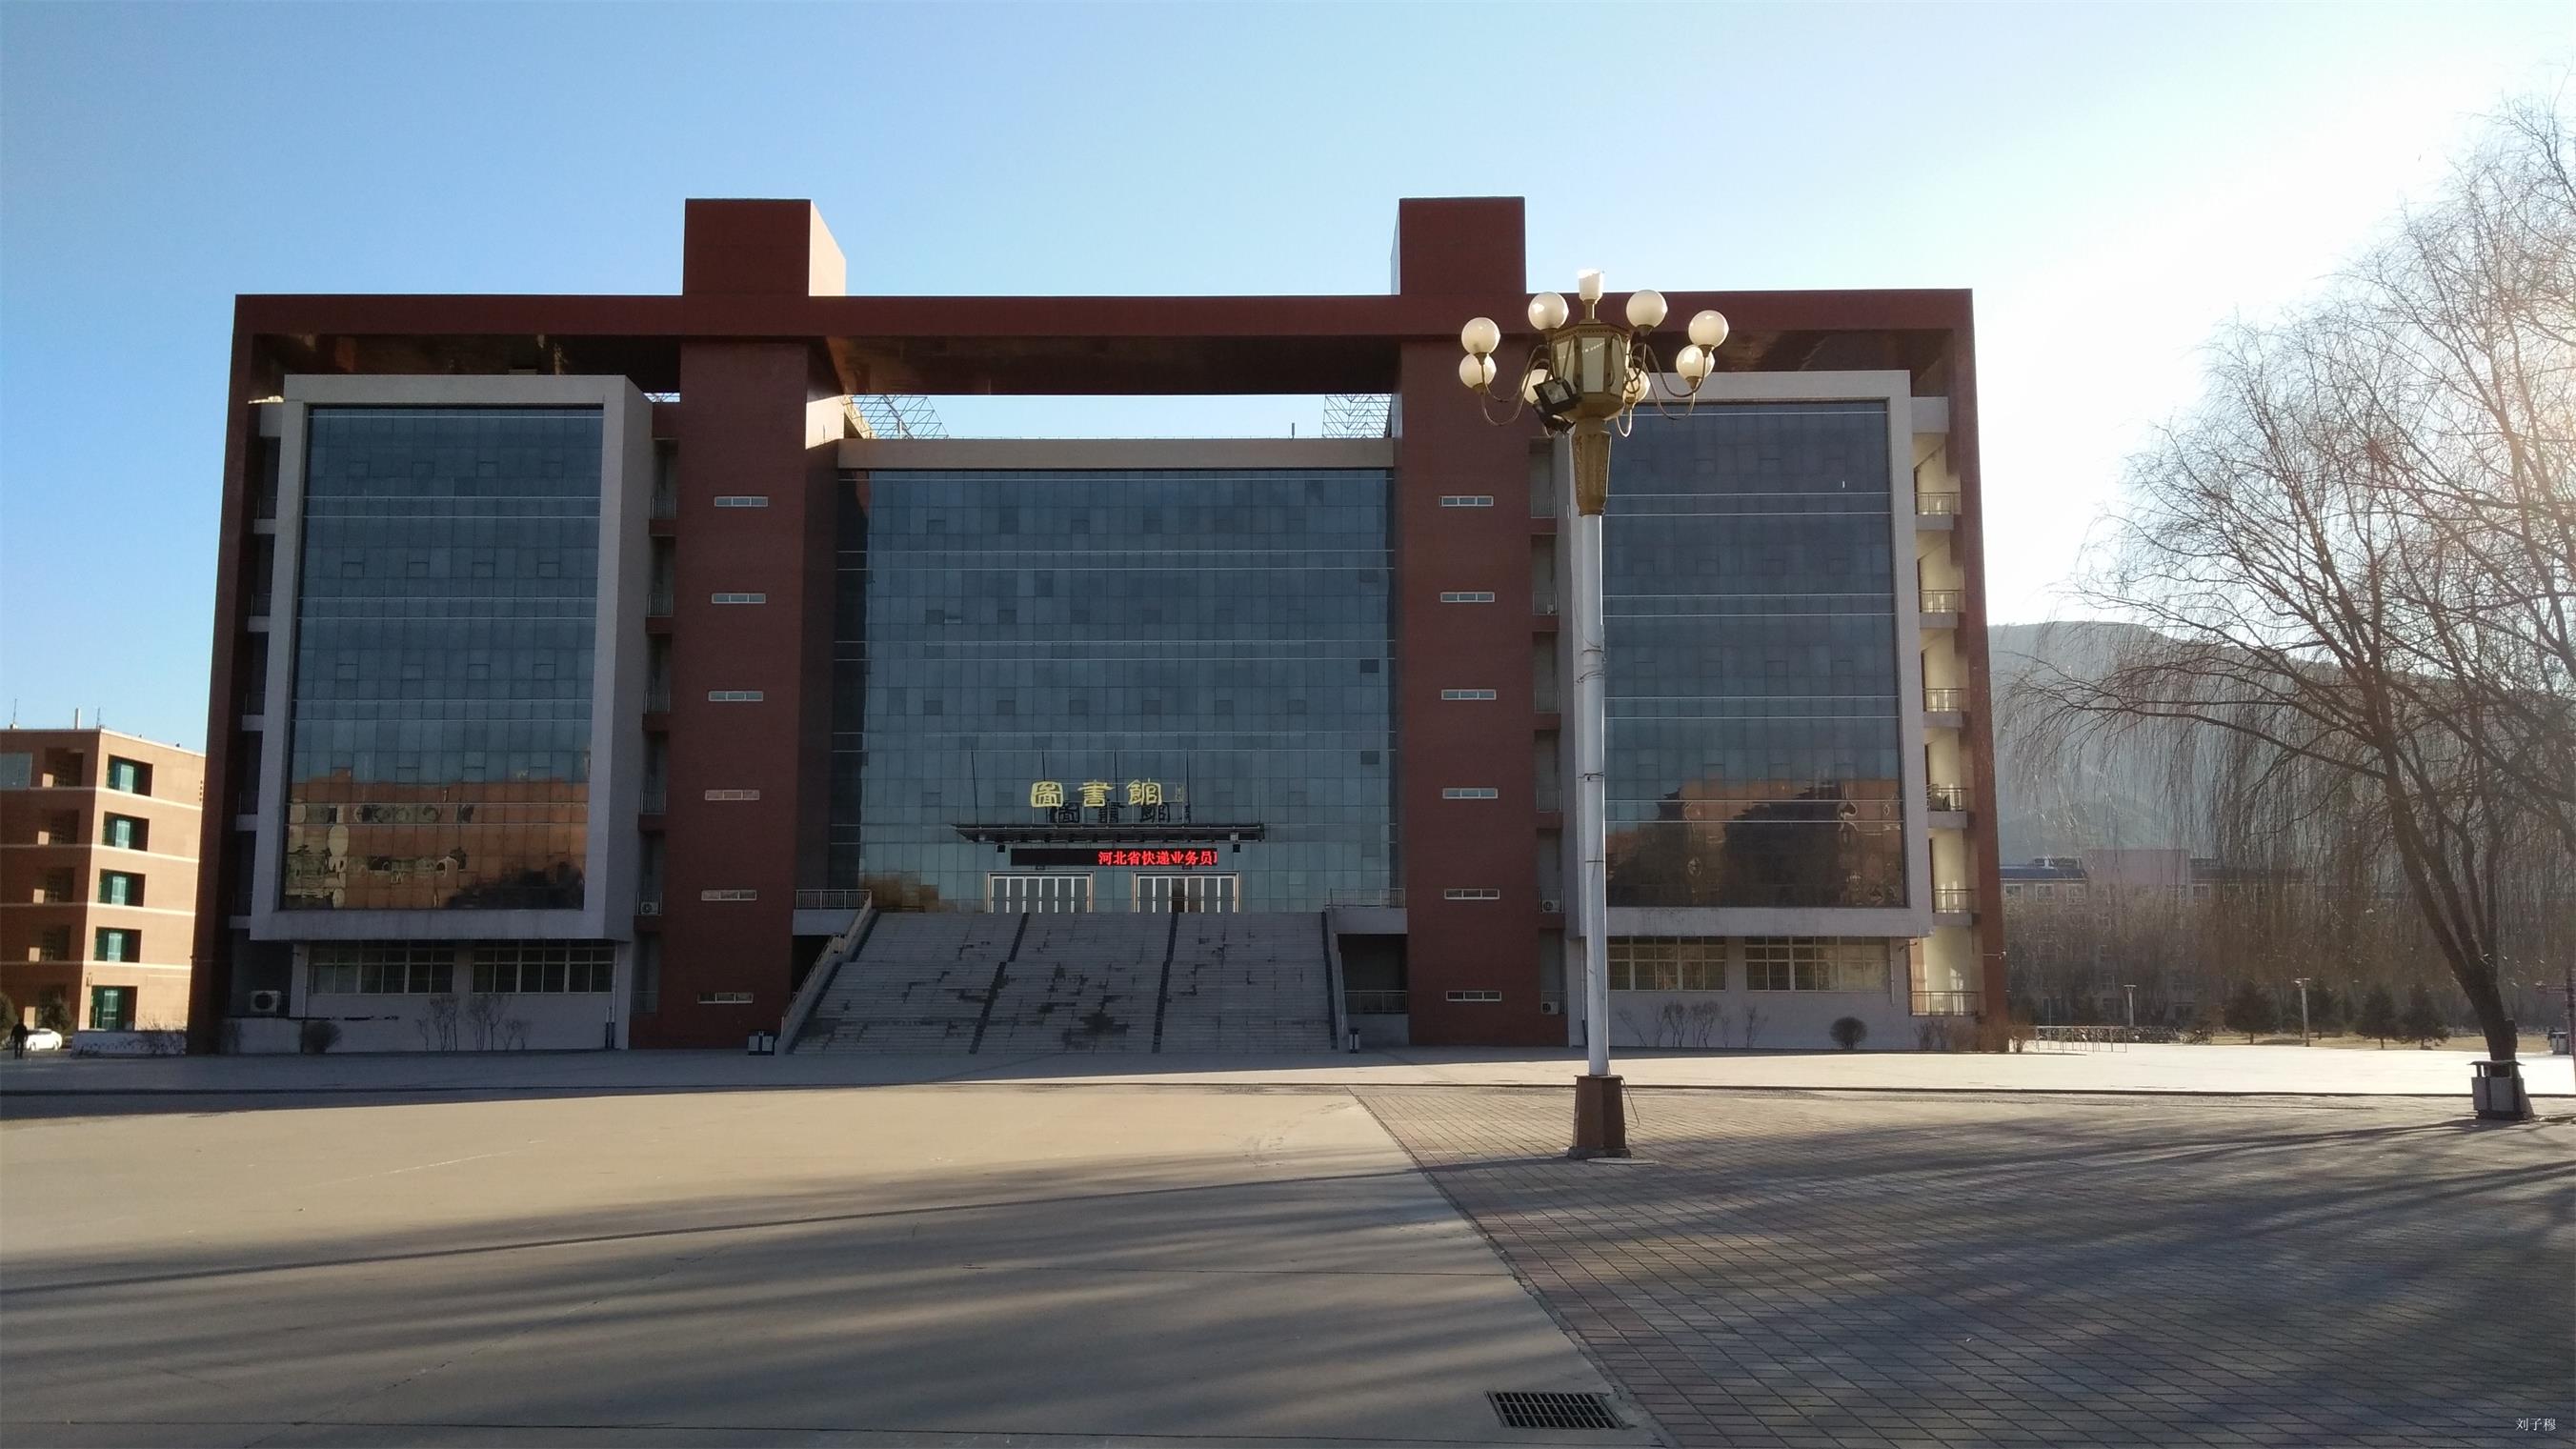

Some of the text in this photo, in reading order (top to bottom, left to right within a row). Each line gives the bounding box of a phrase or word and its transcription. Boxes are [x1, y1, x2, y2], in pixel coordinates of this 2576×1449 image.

[1031, 778, 1162, 807] 圖書館
[1098, 851, 1218, 866] 河北省快递业务员
